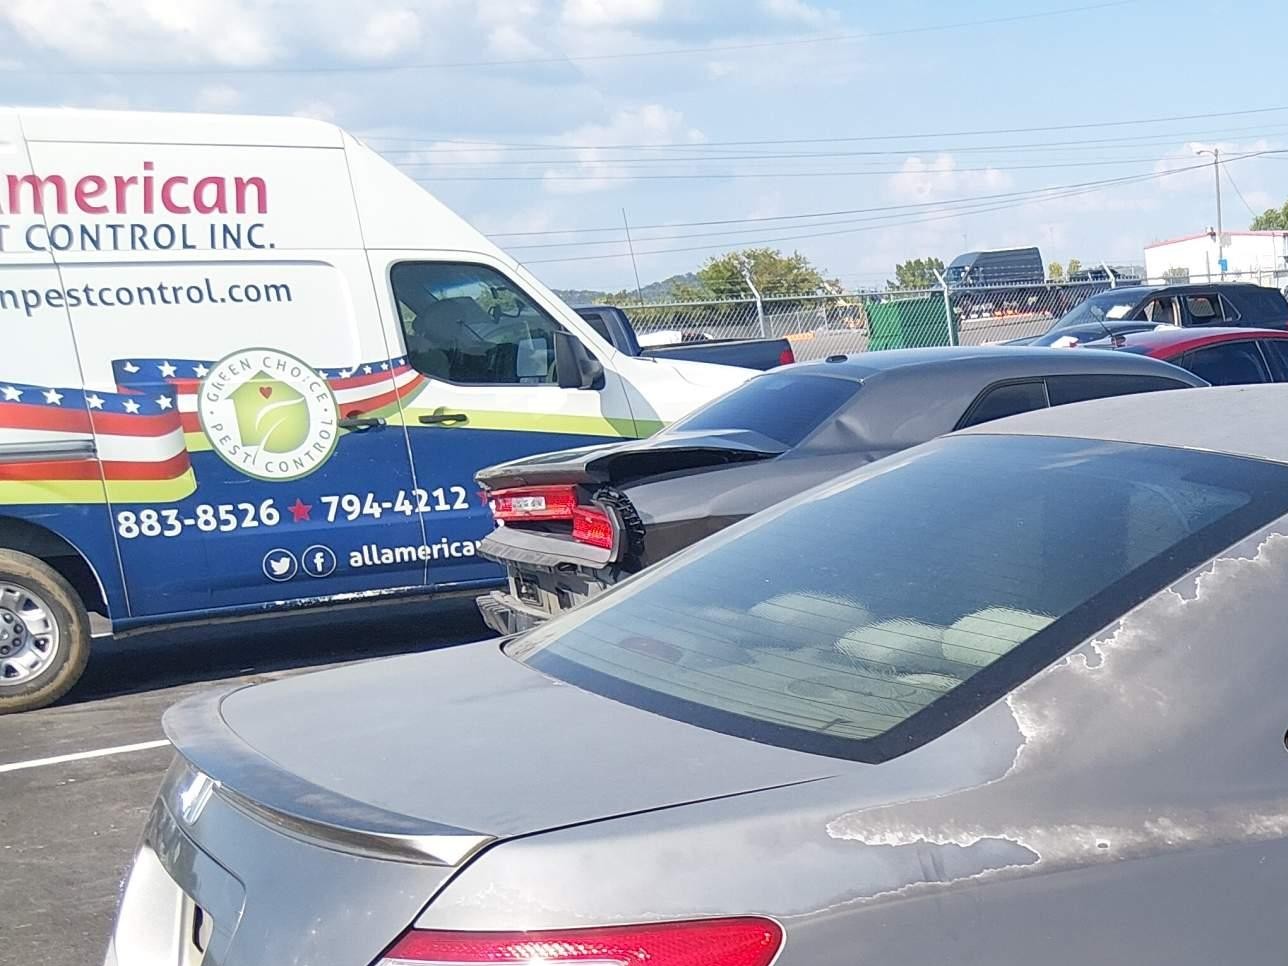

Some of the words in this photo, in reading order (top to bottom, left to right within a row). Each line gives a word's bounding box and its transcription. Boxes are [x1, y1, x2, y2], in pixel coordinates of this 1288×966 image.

[0, 161, 268, 215] merican
[25, 223, 196, 251] CONTROL
[210, 223, 275, 249] INC.
[206, 358, 252, 402] GREEN
[211, 423, 252, 463] PEST
[265, 419, 333, 473] CONTROL
[117, 498, 280, 539] 883-8526
[321, 485, 469, 523] 794-4212
